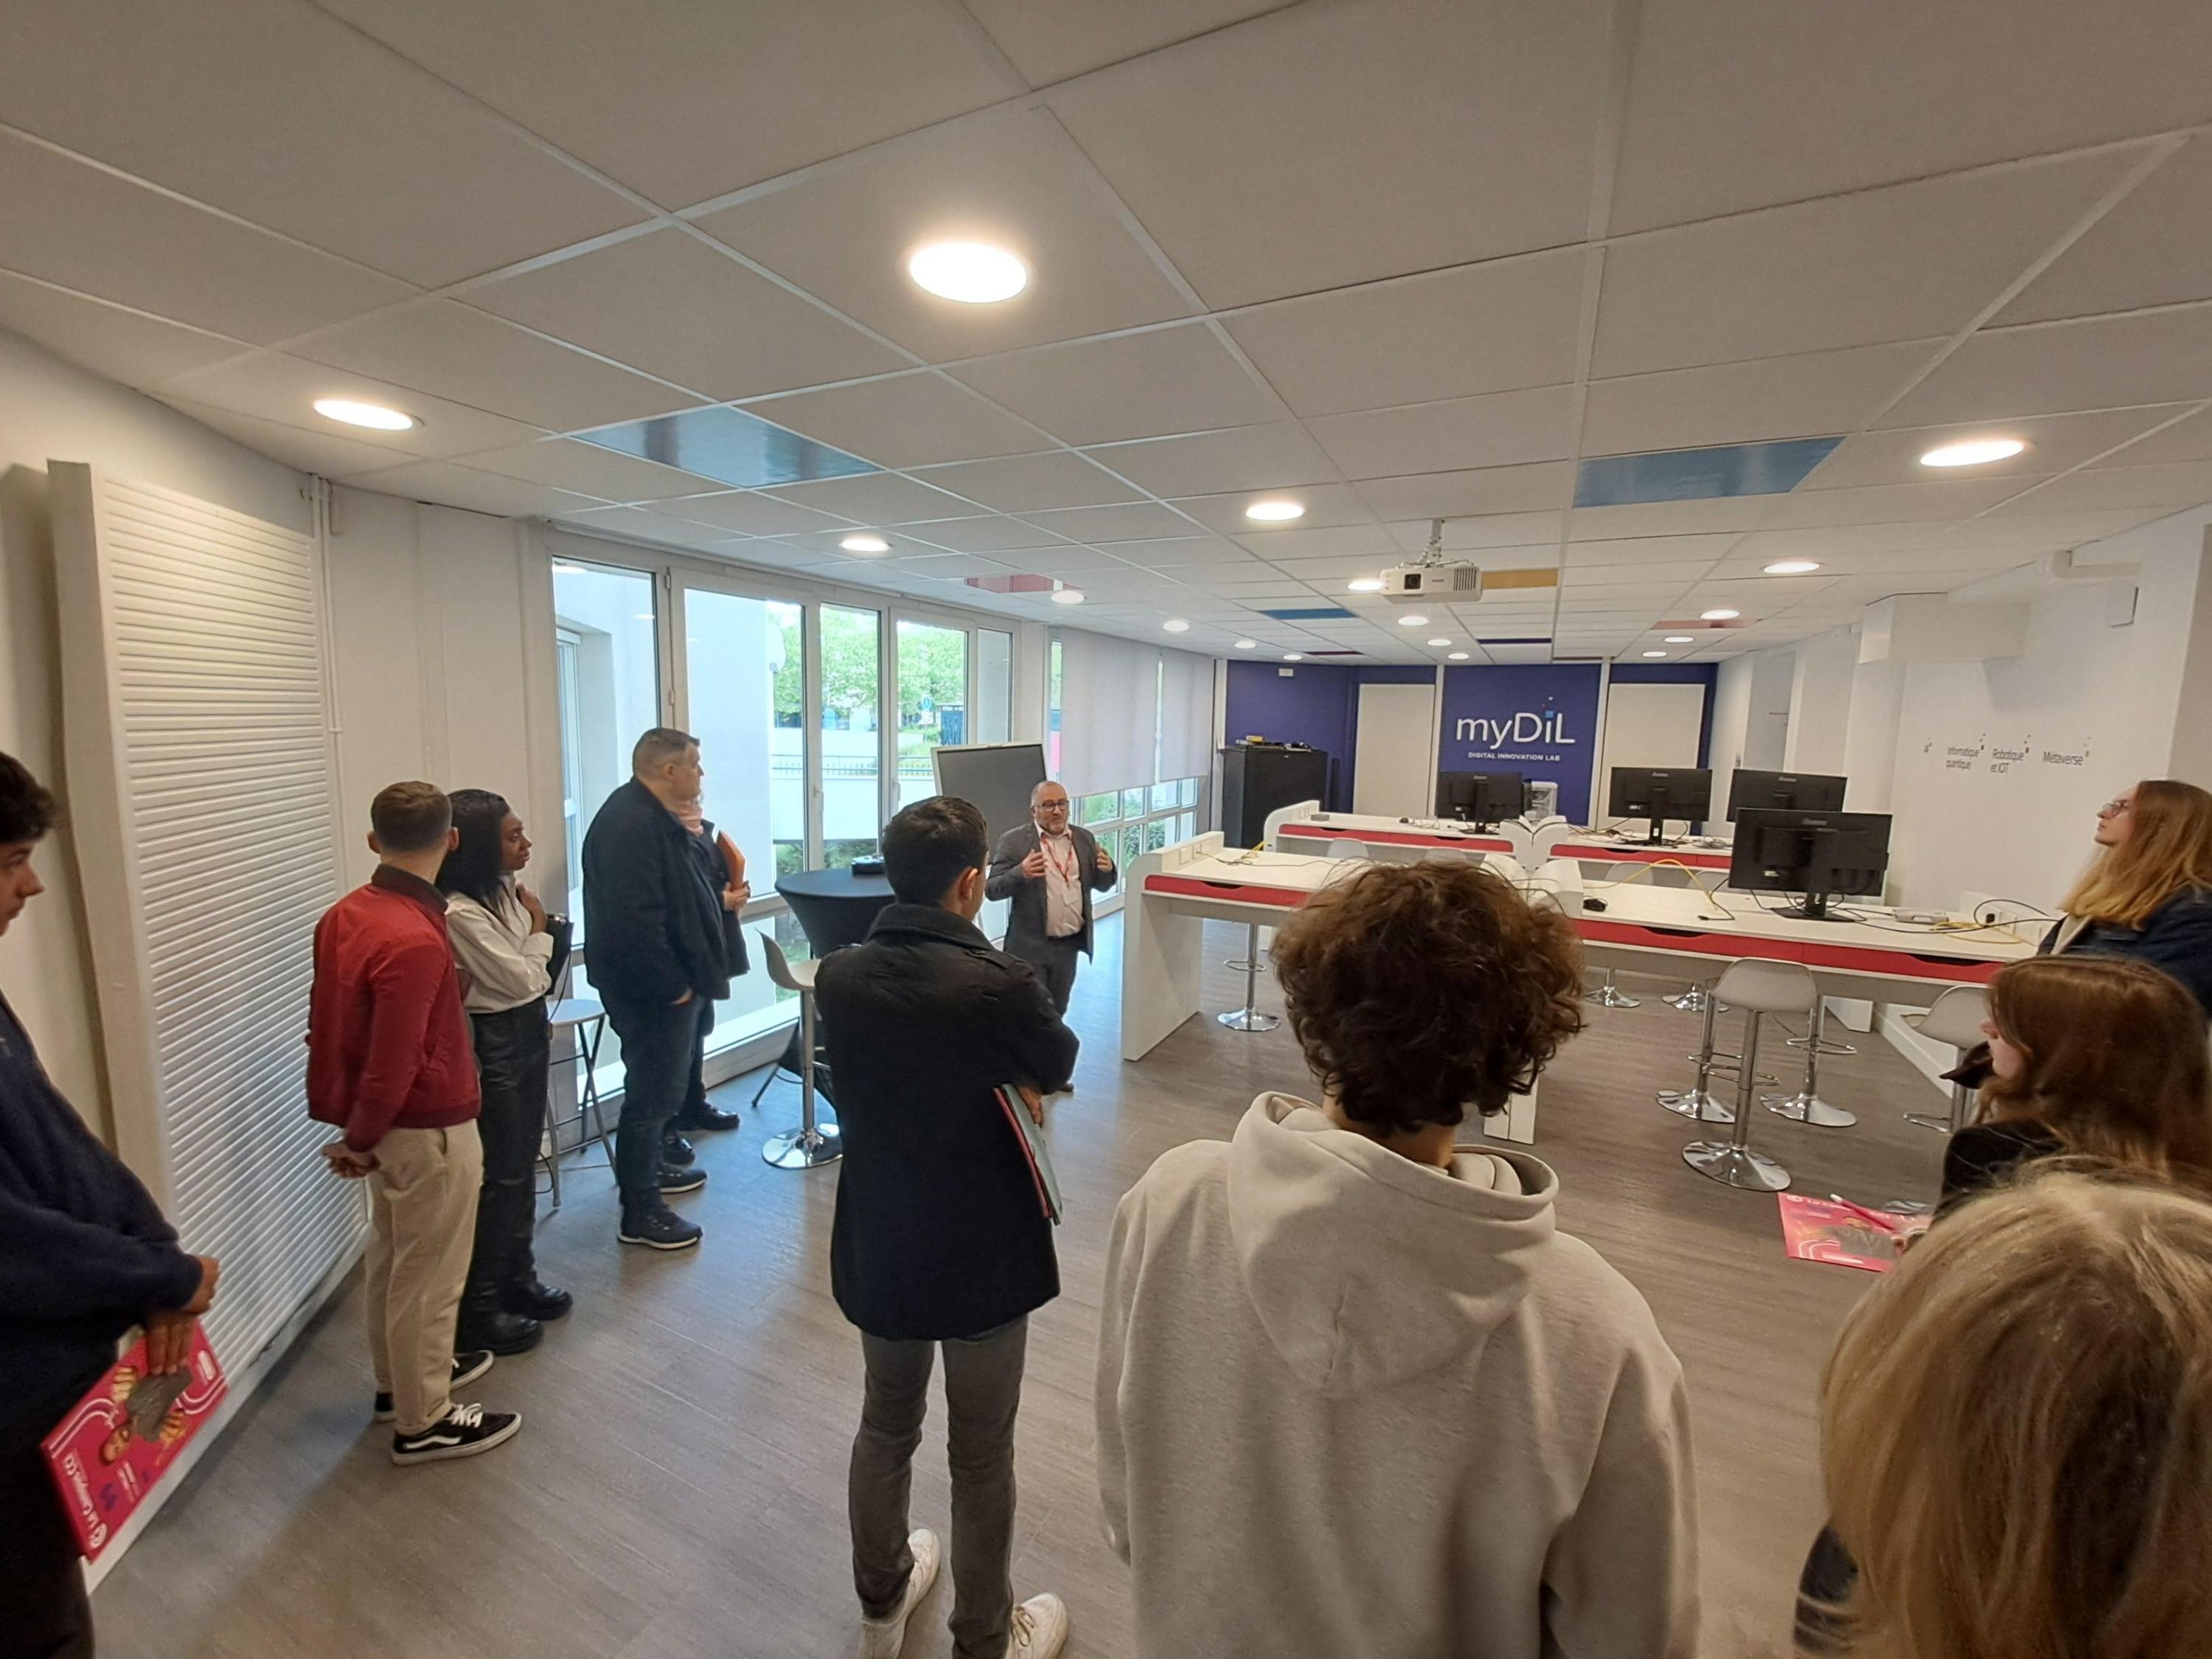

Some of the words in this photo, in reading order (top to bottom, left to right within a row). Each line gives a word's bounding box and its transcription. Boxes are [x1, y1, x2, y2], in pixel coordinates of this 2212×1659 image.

[1456, 710, 1576, 750] myDiL
[1468, 751, 1496, 759] DIGITAL
[1497, 753, 1544, 761] INNOVATION
[1992, 748, 2025, 762] Robotique
